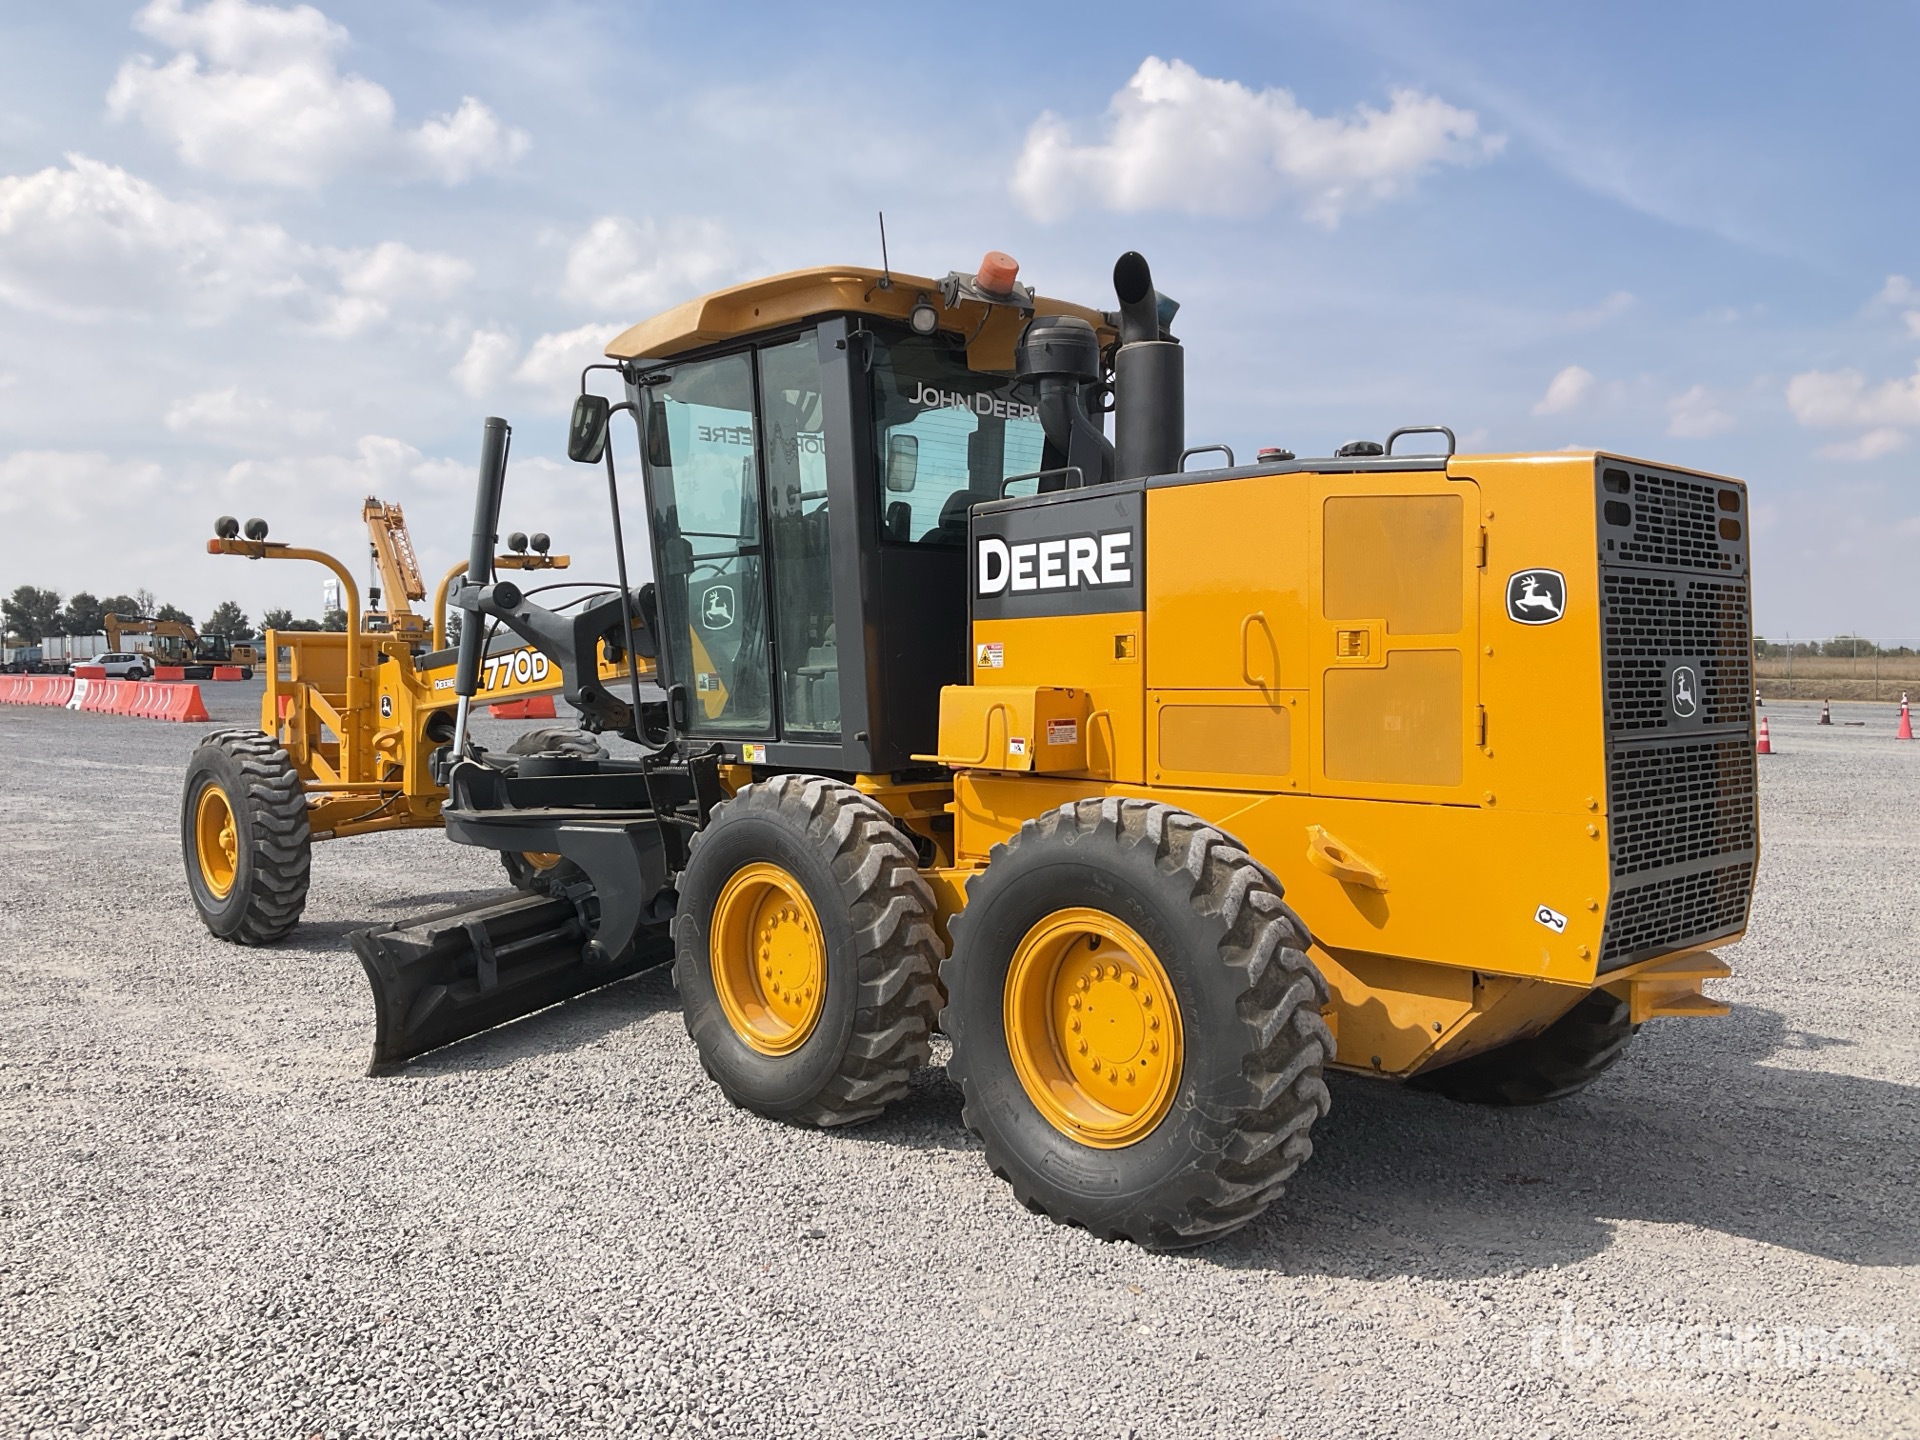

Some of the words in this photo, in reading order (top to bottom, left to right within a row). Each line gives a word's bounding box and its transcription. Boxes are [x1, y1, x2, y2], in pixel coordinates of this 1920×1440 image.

[908, 381, 972, 414] JOHN
[978, 531, 1131, 595] DEERE
[434, 678, 456, 691] DEERE
[484, 648, 549, 692] 770D
